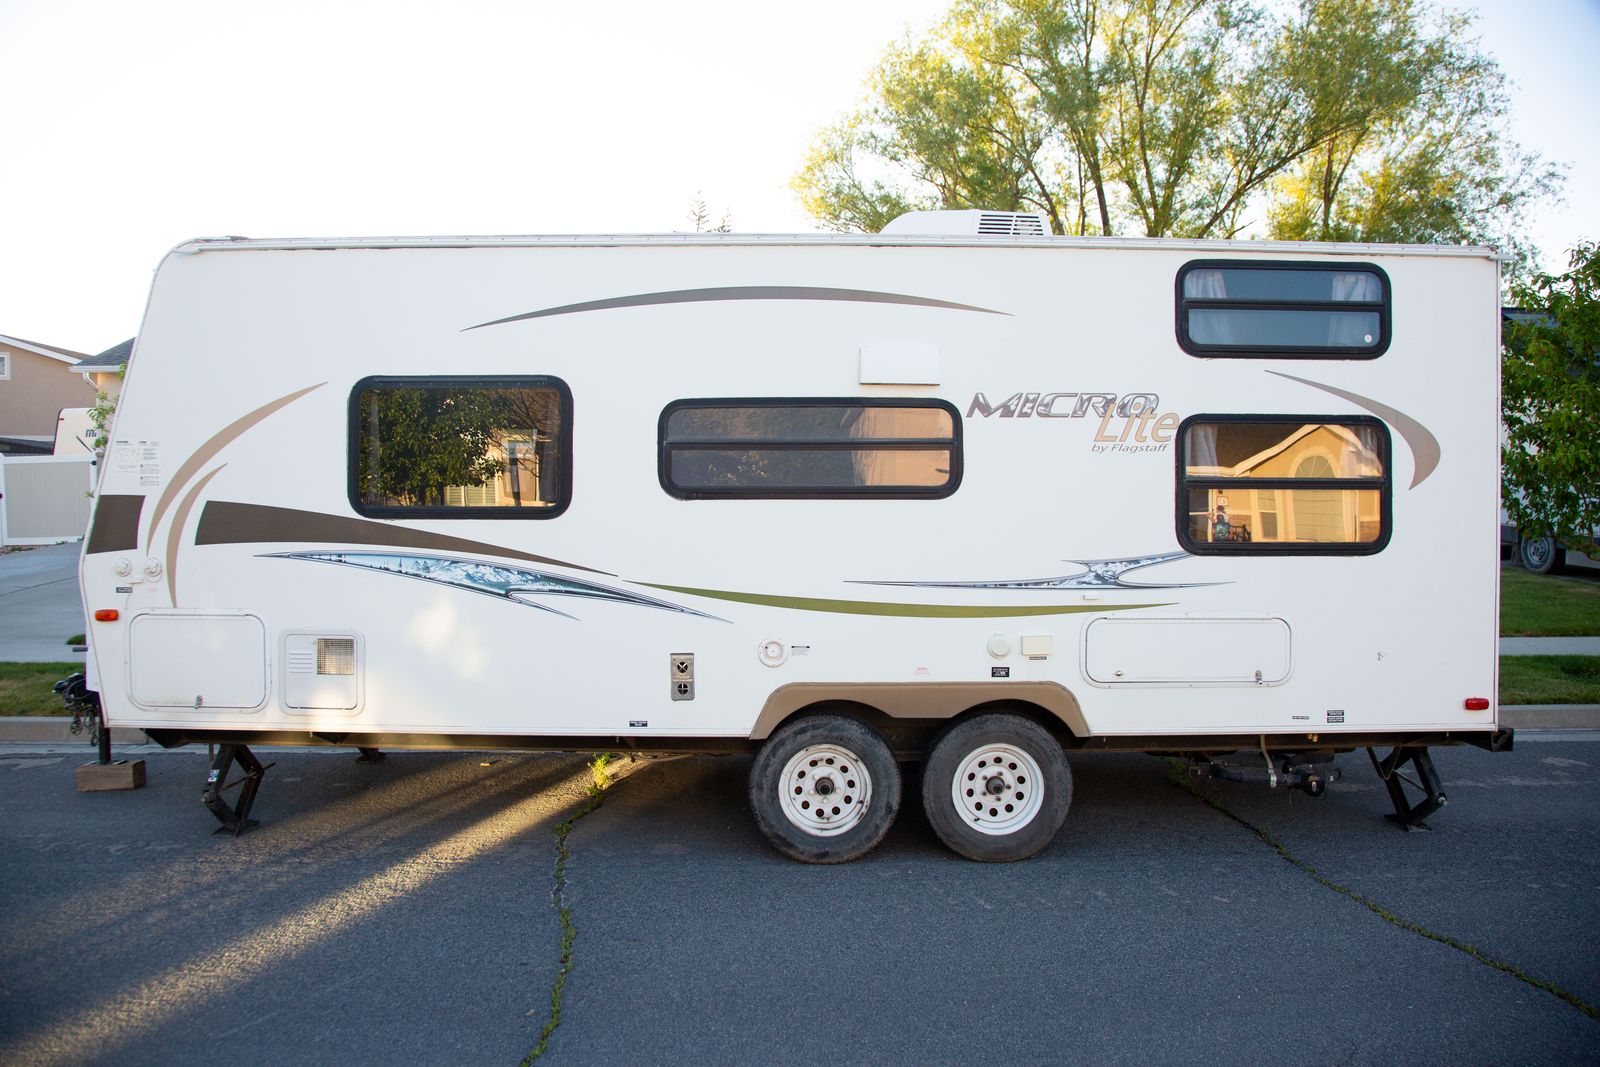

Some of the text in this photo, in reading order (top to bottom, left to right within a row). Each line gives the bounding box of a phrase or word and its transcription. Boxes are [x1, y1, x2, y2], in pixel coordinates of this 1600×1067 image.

[966, 392, 1160, 418] MICRO
[1094, 402, 1180, 443] Lite
[1091, 443, 1168, 454] by Flagstaff
